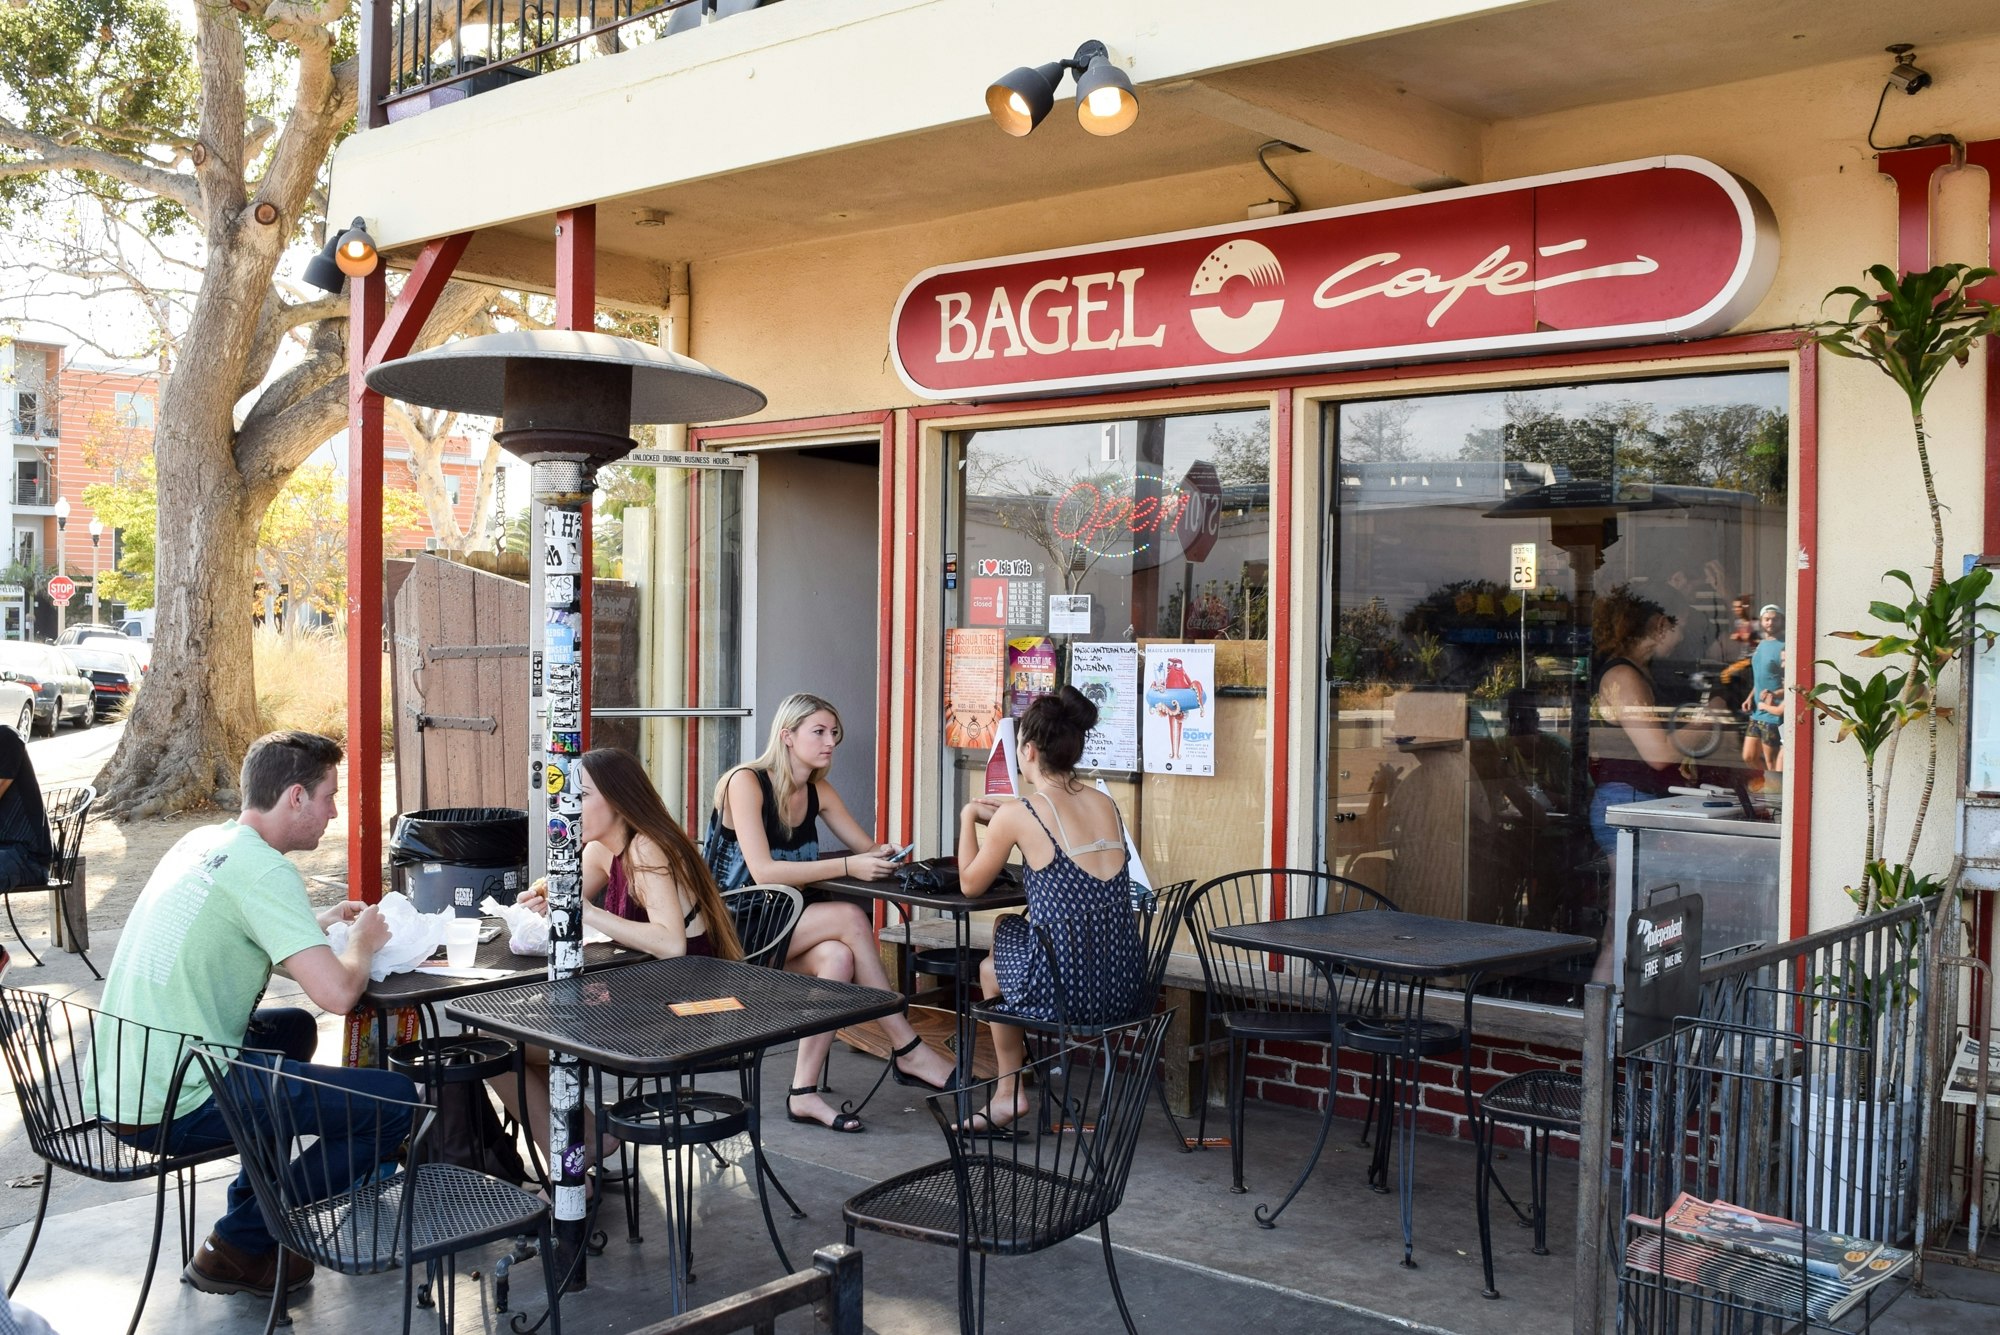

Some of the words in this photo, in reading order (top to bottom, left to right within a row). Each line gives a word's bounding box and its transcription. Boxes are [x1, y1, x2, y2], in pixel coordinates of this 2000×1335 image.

[934, 266, 1166, 363] BAGEL
[1312, 237, 1660, 329] Café
[1105, 424, 1116, 460] 1
[632, 454, 659, 462] UNLOCKED
[663, 455, 682, 463] DURING
[685, 456, 710, 465] BUSINESS
[713, 457, 730, 465] HOURS
[1053, 482, 1190, 544] Open
[999, 561, 1011, 575] Isla
[1013, 561, 1032, 575] Vista
[51, 583, 72, 593] STOP
[953, 634, 978, 645] JOSHUA
[979, 634, 996, 646] TREE
[953, 645, 971, 654] MUSIC
[971, 645, 996, 655] FESTIVAL
[1090, 646, 1119, 654] LANTERN
[1017, 656, 1042, 665] RESILIENT
[533, 657, 542, 685] PUSH
[1073, 663, 1113, 673] CALENDAR
[552, 732, 580, 743] DESE
[1182, 731, 1213, 740] DORY
[552, 743, 579, 753] HEAR
[1645, 916, 1683, 952] Independent
[1644, 958, 1659, 978] FREE
[1664, 954, 1675, 968] TAKE
[1674, 951, 1683, 965] ONE
[405, 1014, 415, 1041] SANTA
[349, 1021, 360, 1061] BARBARA
